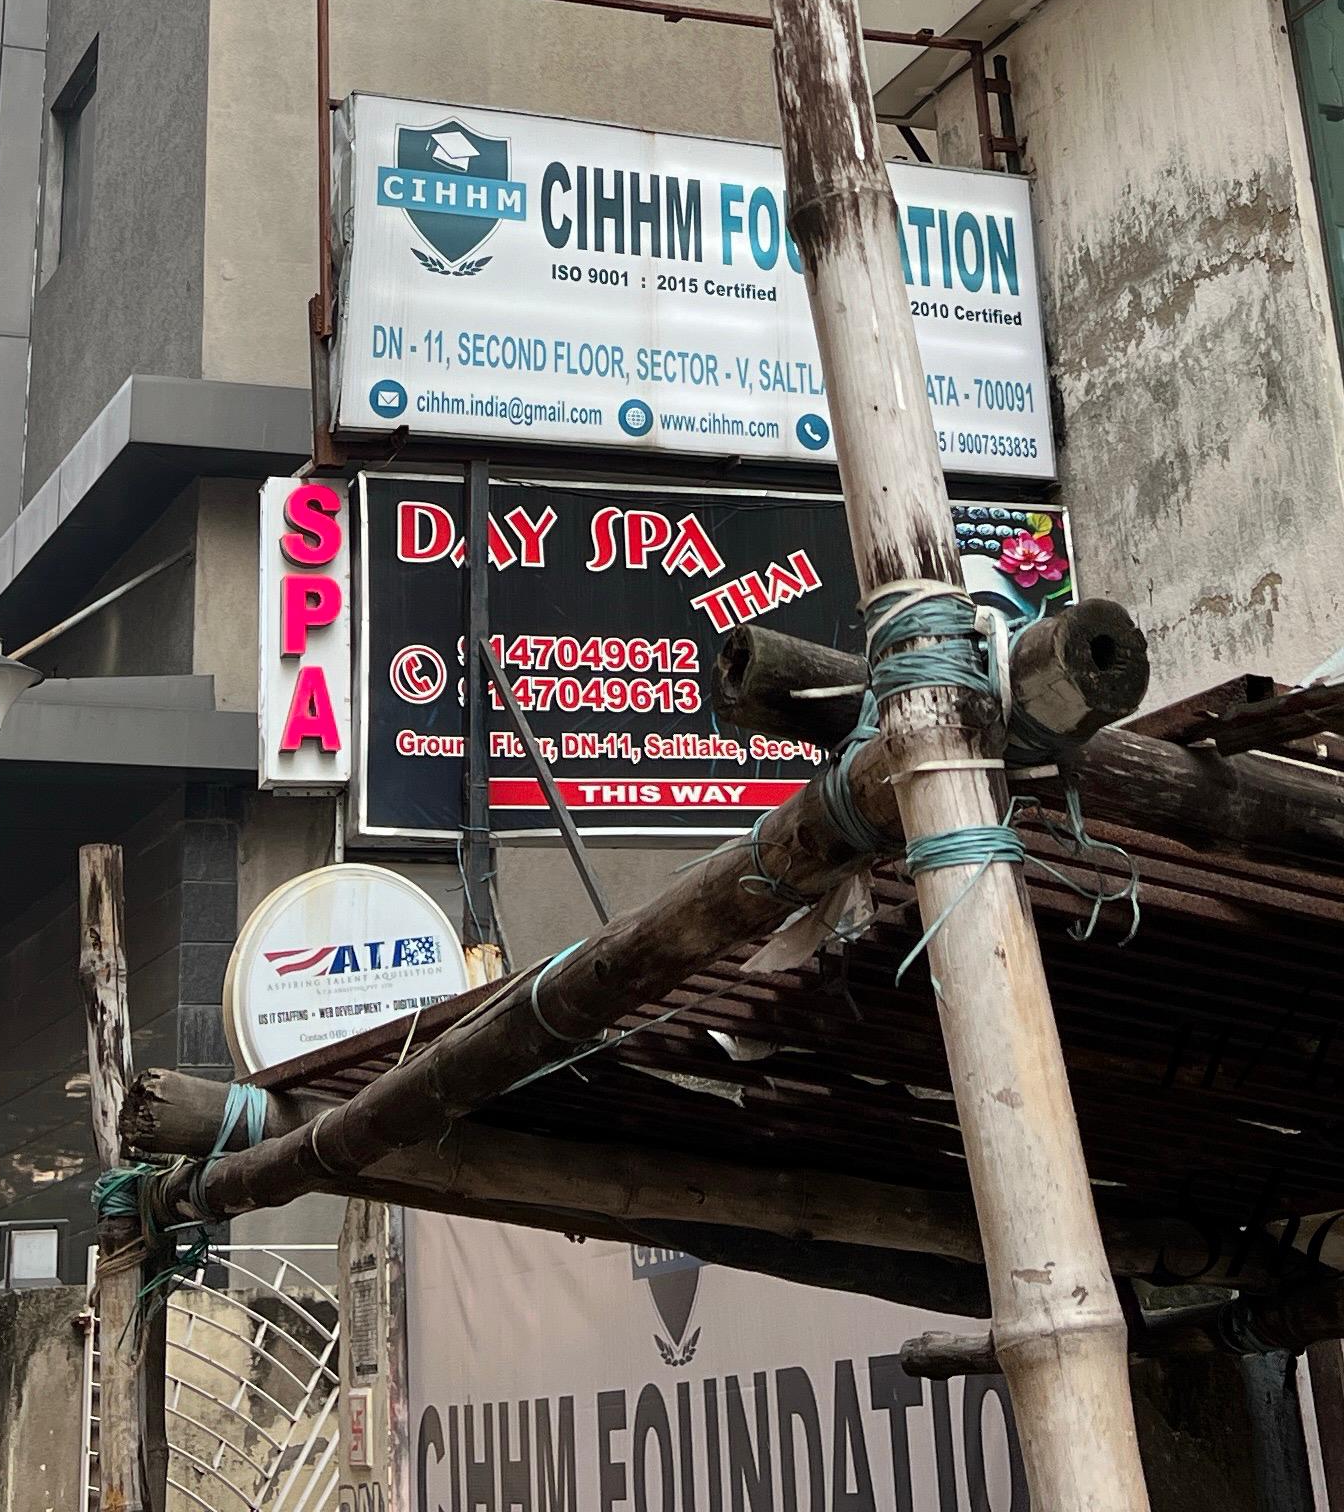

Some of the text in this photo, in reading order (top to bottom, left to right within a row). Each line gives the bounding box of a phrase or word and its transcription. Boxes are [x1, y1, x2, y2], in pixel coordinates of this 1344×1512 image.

[382, 175, 522, 213] CIHHM
[541, 161, 703, 263] CIHHM
[552, 263, 581, 282] ISO
[588, 268, 629, 287] 9001
[656, 274, 698, 295] 2015
[704, 279, 777, 302] Certified
[911, 300, 949, 319] 2010
[954, 305, 1022, 327] Certified
[372, 325, 403, 360] DN
[423, 329, 451, 370] 11,
[457, 332, 547, 372] SECOND
[554, 340, 630, 384] FLOOR,
[636, 347, 719, 387] SECTOR
[735, 357, 753, 396] V,
[974, 378, 1034, 414] 700091
[416, 390, 603, 426] cihhm.india@gmail.com
[660, 412, 780, 439] www.cihhm.com
[958, 433, 1038, 460] 9007353835
[586, 505, 725, 578] SPA
[281, 483, 344, 755] SPA
[690, 549, 822, 634] THAI
[396, 729, 465, 758] Grou
[489, 731, 558, 764] Flor,
[561, 732, 642, 765] DN-11,
[644, 733, 748, 766] Saltlake,
[577, 784, 747, 803] THIS WAY
[335, 1002, 382, 1018] DEVELOPMENT
[597, 1352, 1032, 1512] FOUNDATIO
